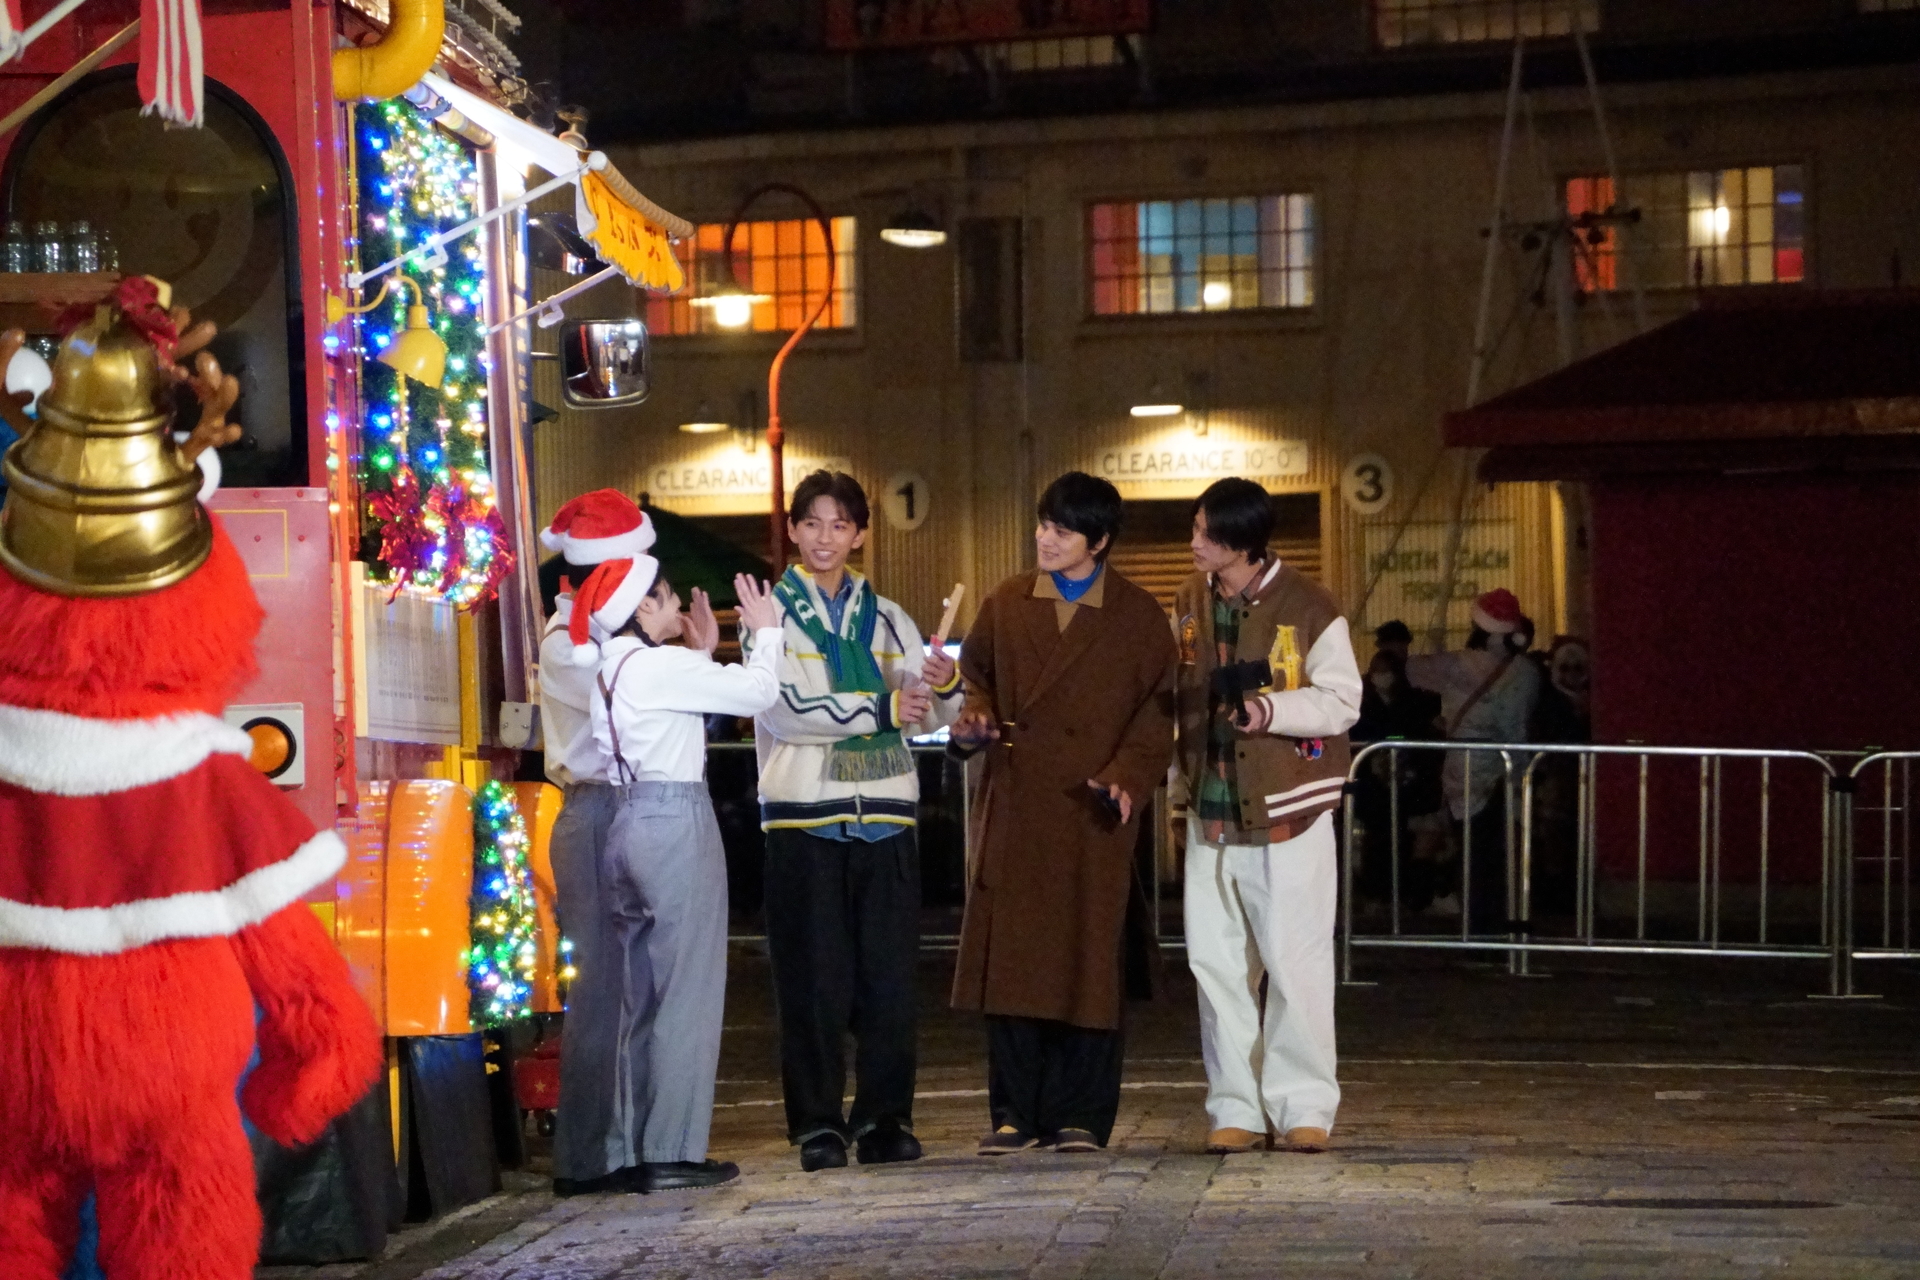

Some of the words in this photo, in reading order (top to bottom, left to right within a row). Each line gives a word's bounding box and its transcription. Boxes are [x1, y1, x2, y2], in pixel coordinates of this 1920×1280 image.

[655, 466, 769, 491] CLEARANC
[1102, 449, 1235, 476] CLEARANCE
[896, 481, 915, 520] 1
[1354, 463, 1384, 502] 3
[1259, 624, 1303, 694] A
